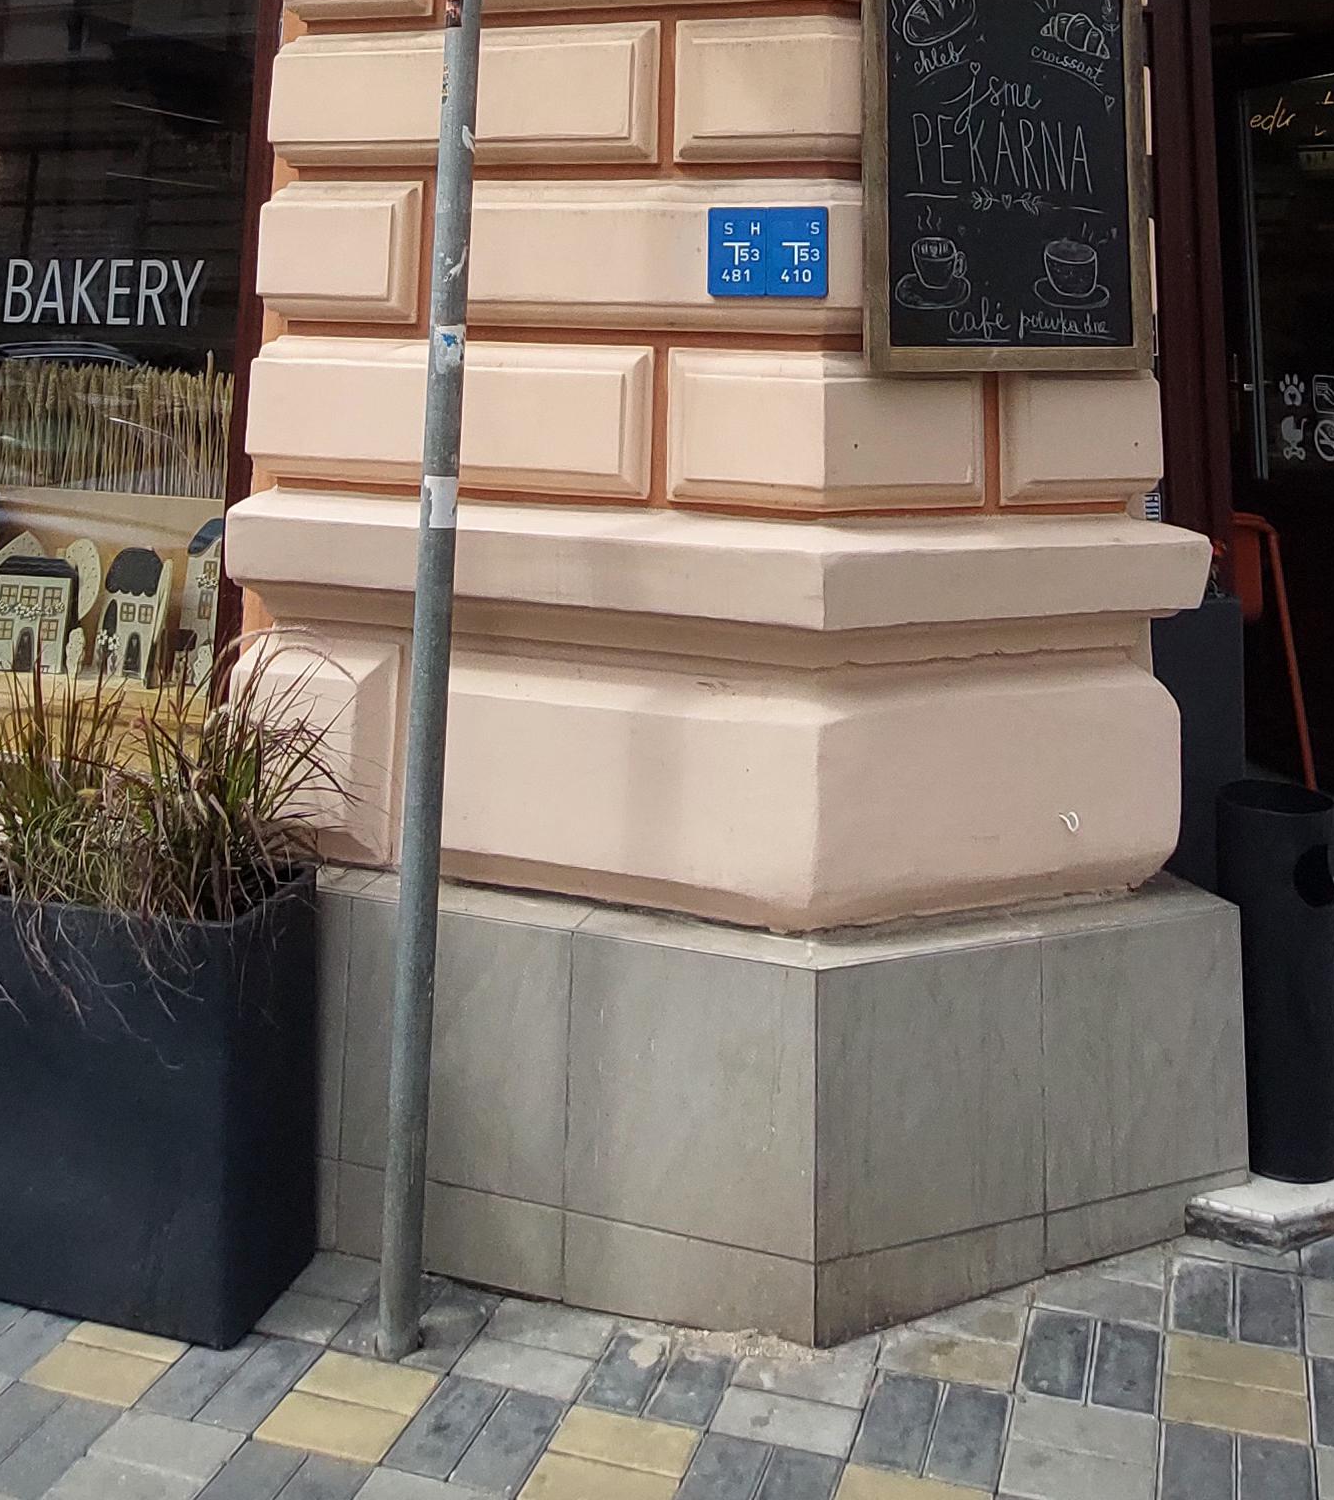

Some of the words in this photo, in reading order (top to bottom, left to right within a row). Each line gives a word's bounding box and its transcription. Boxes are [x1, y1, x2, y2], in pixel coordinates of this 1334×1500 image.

[914, 41, 967, 75] chléb
[913, 109, 1093, 194] PEKÁRNA
[2, 257, 206, 328] BAKERY
[721, 269, 751, 282] 481
[781, 269, 812, 283] 410
[949, 296, 1012, 340] café
